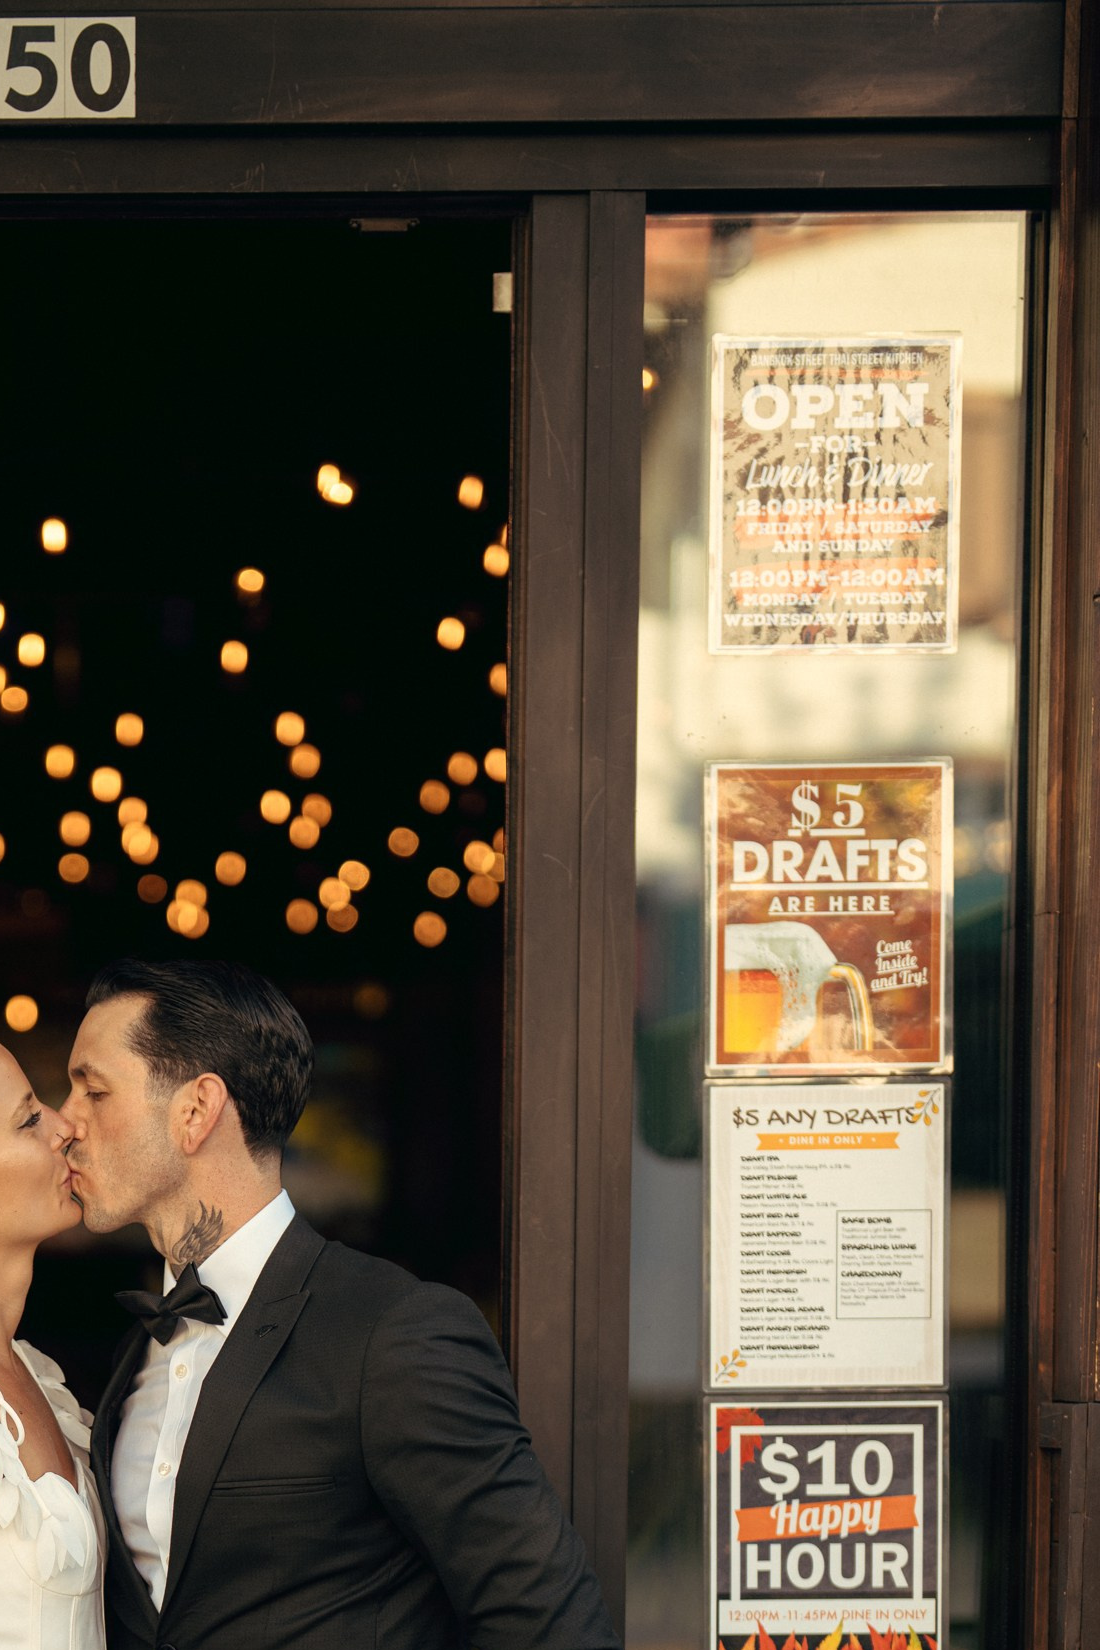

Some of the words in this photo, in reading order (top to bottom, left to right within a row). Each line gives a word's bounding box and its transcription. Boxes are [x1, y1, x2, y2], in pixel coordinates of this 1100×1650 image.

[751, 353, 793, 366] BANGKOK
[795, 353, 826, 366] STREET
[830, 353, 849, 365] THAI
[852, 352, 883, 365] STREET
[886, 351, 922, 364] KITCHEN
[741, 383, 929, 431] OPEN
[746, 458, 818, 490] Lunch
[847, 456, 933, 487] Dinner
[746, 521, 814, 535] FRIDAY
[834, 520, 933, 534] SATURDAY
[772, 539, 814, 553] AND
[819, 538, 895, 552] SUNDAY
[742, 593, 822, 607] MONDAY
[844, 592, 927, 605] TUESDAY
[732, 838, 928, 882] DRAFTS
[769, 896, 815, 913] ARE
[829, 895, 891, 912] HERE
[876, 940, 912, 954] Come
[875, 954, 917, 971] Inside
[871, 973, 897, 989] and
[899, 966, 928, 988] Try!
[733, 1106, 759, 1128] $5
[768, 1109, 817, 1130] ANY
[823, 1107, 916, 1126] DRAFTS
[789, 1136, 814, 1145] DINE
[818, 1136, 830, 1144] IN
[834, 1135, 863, 1144] ONLY
[758, 1437, 894, 1500] $10
[770, 1499, 882, 1541] Happy
[746, 1542, 909, 1590] HOUR
[728, 1610, 780, 1621] 12:00PM
[843, 1609, 871, 1620] DINE
[875, 1609, 889, 1619] IN
[894, 1608, 926, 1619] ONLY
